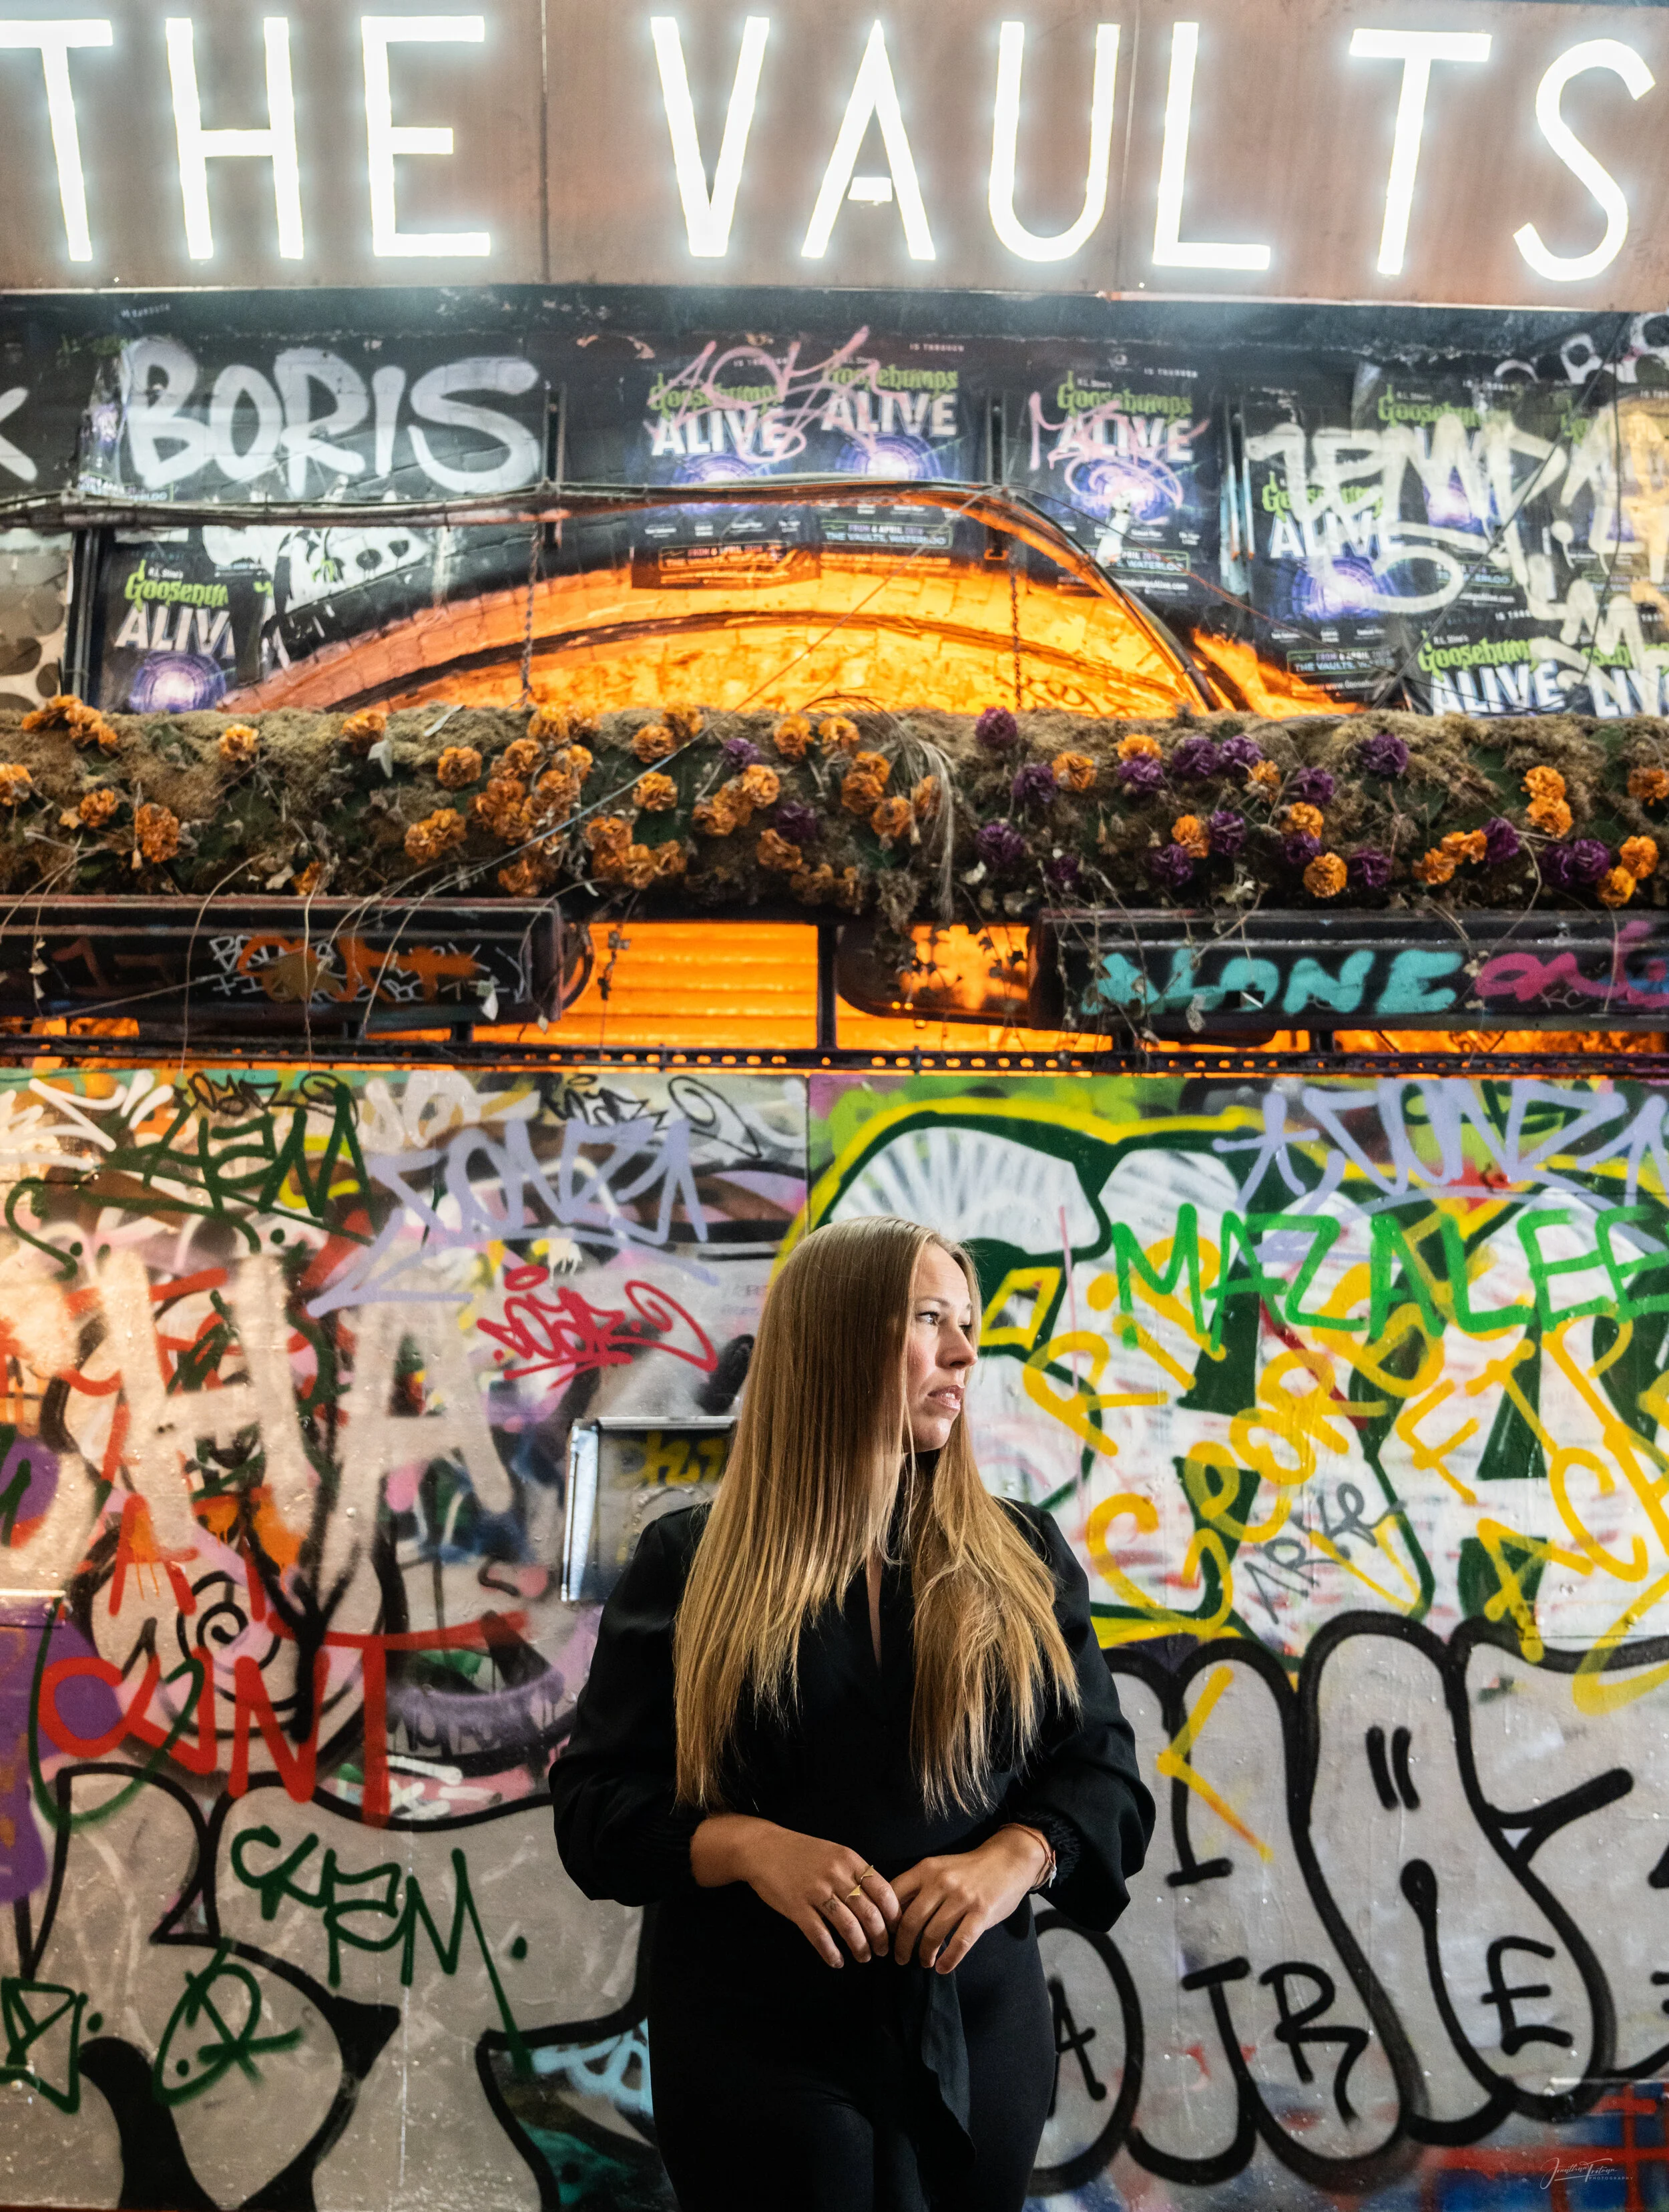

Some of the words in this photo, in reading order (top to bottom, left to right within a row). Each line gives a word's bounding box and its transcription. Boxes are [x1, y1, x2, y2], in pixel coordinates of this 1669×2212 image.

[0, 15, 492, 262] THE
[651, 15, 1656, 282] VAULTS
[122, 335, 540, 497] BORIS
[651, 405, 783, 456] ALIVE
[820, 390, 958, 436] ALIVE
[1056, 412, 1193, 462] ALIVE
[113, 602, 235, 658] ALIV
[1432, 658, 1566, 717] ALIVE
